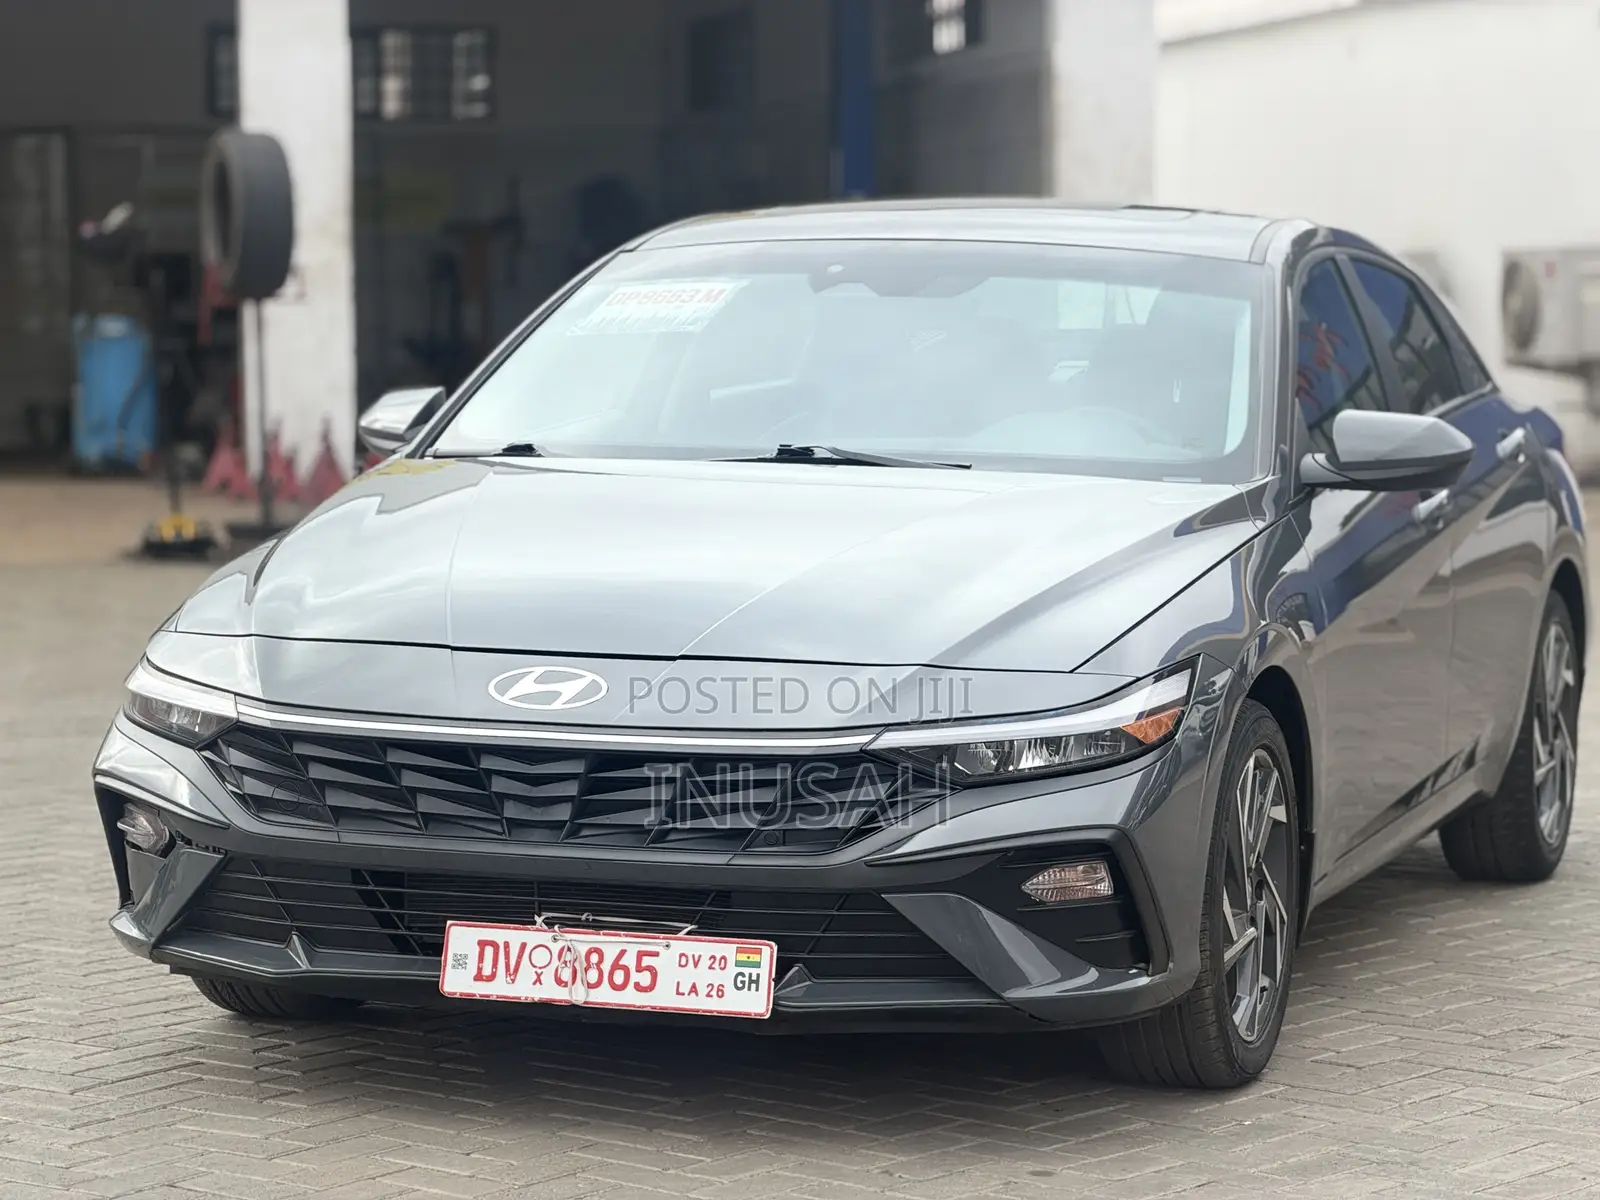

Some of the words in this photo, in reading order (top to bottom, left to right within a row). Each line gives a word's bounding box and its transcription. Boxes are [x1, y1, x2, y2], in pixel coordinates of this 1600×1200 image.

[473, 939, 527, 985] DV
[554, 943, 660, 994] 8865
[678, 952, 702, 969] DV
[707, 954, 728, 971] 20
[675, 980, 699, 997] LA
[705, 982, 726, 999] 26
[733, 971, 761, 992] GH
